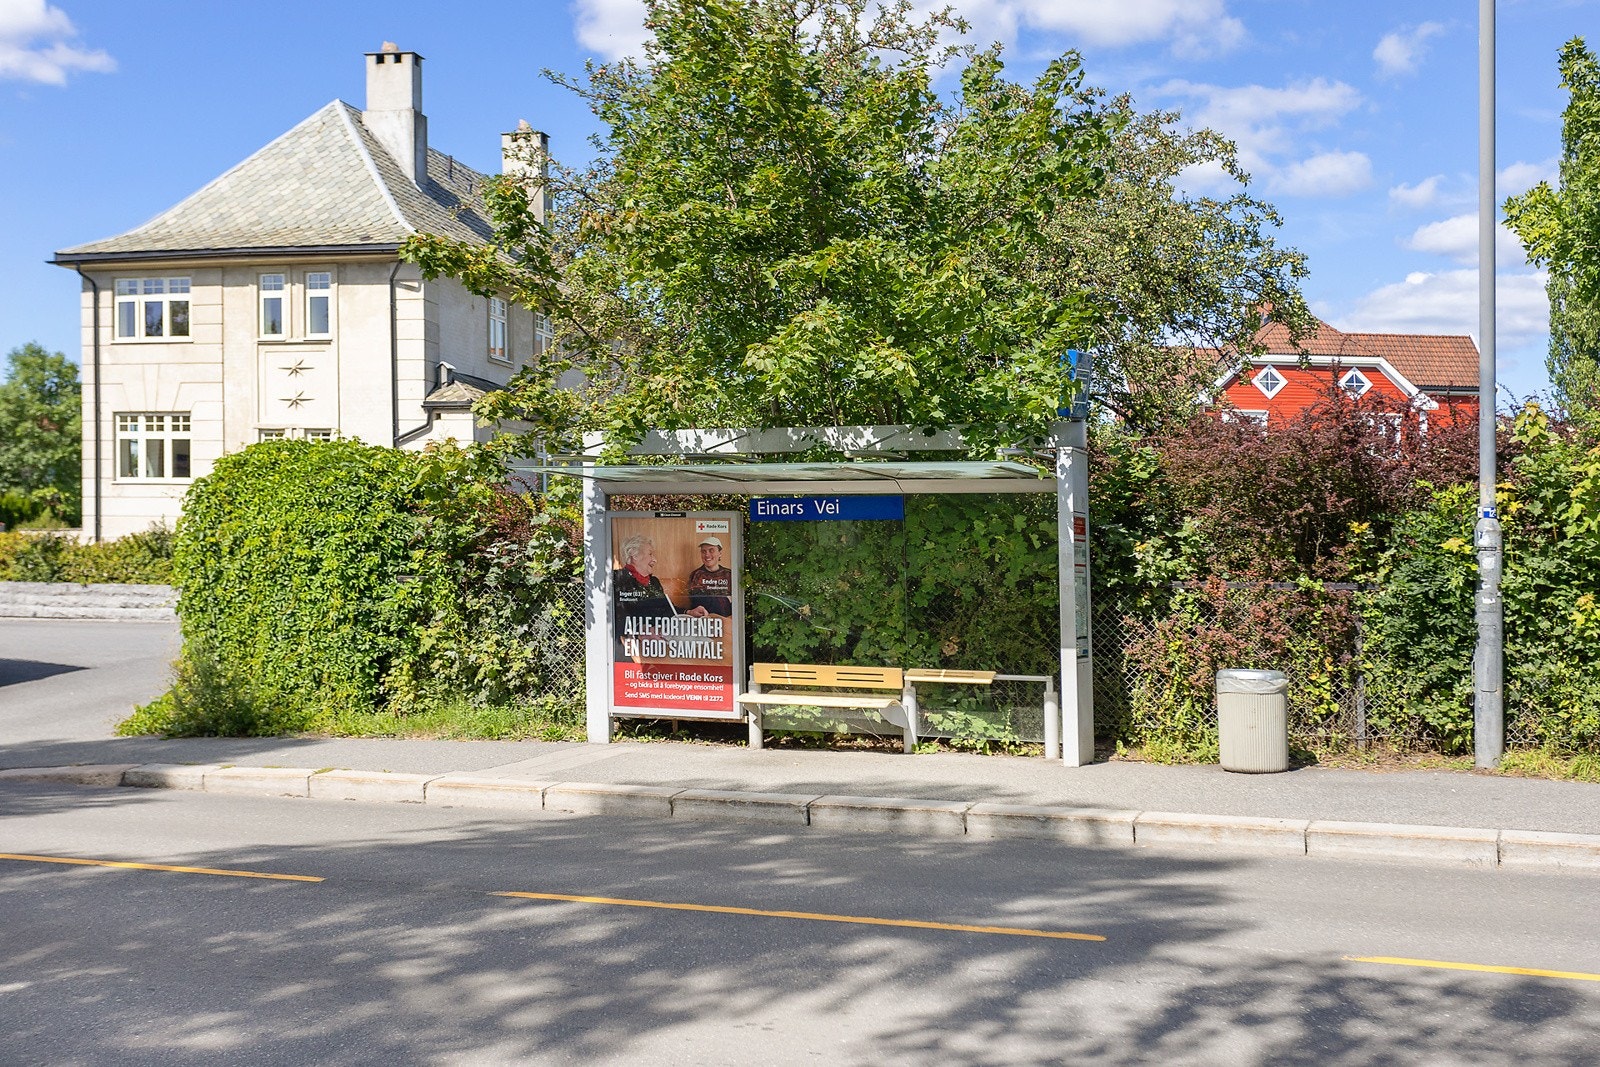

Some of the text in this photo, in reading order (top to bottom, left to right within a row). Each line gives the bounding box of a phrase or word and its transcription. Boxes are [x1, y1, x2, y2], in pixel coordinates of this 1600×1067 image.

[757, 499, 840, 515] Einars Vei
[624, 616, 723, 638] ALLE FORTJENER
[624, 638, 723, 660] EN GOD SAMTALE
[624, 670, 634, 679] Bli
[636, 670, 650, 680] fast
[652, 672, 673, 682] giver
[680, 672, 702, 682] Røde
[704, 674, 723, 682] Kors
